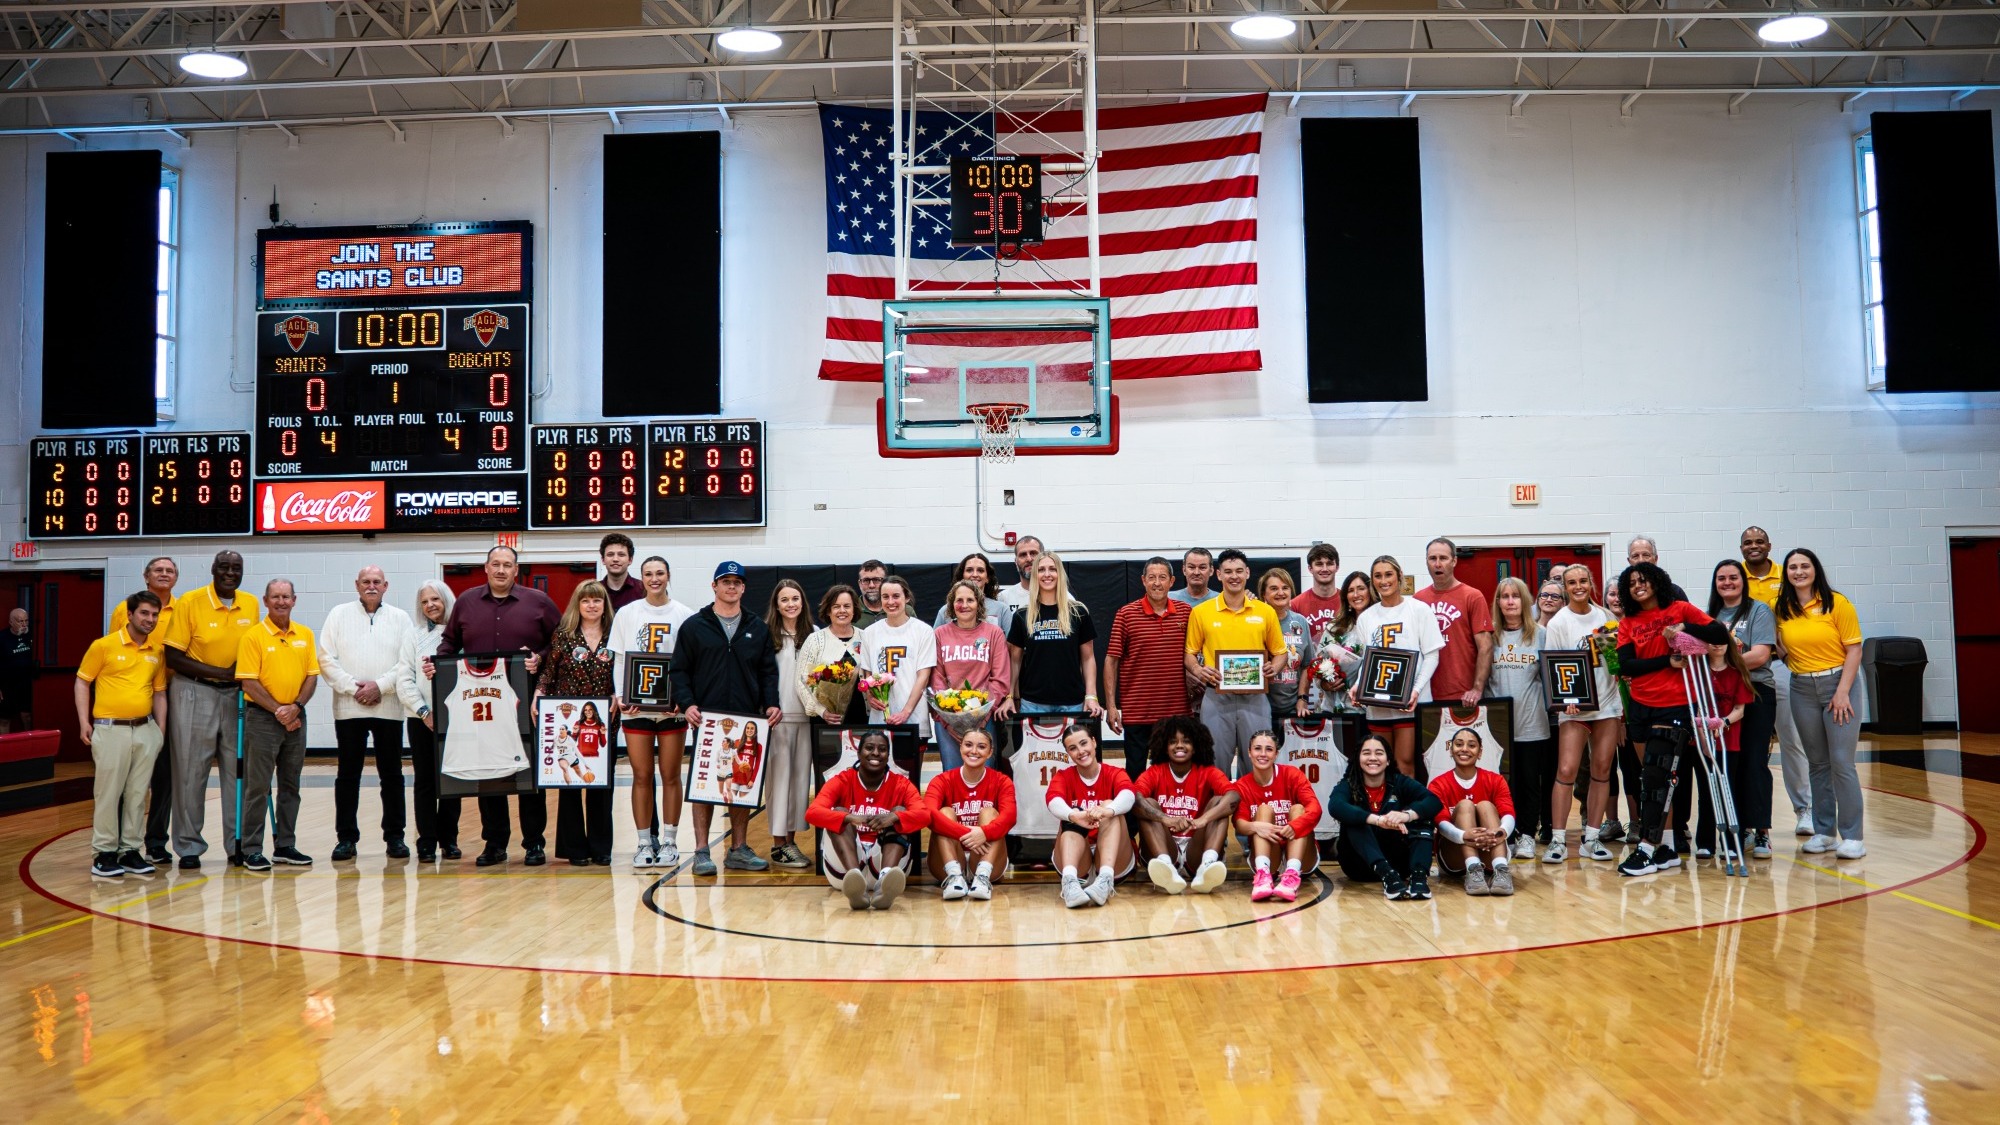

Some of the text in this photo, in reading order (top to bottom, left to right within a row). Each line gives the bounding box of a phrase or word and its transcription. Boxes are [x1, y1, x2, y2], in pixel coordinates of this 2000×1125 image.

[974, 192, 1022, 234] 30
[331, 242, 434, 264] JOIN THE
[316, 266, 463, 290] SAINTS CLUB
[358, 312, 438, 346] 10:00
[275, 356, 326, 373] SAINTS
[371, 364, 408, 375] PERIOD
[448, 352, 512, 368] BOBCATS
[306, 378, 325, 411] 0
[393, 381, 398, 404] 1
[490, 374, 508, 406] 0
[268, 416, 302, 428] FOULS
[314, 416, 342, 426] T.O.L.
[354, 414, 426, 426] PLAYER FOUL
[436, 412, 466, 424] T.O.L.
[479, 411, 514, 422] FOULS
[282, 430, 296, 456] 0
[320, 432, 336, 453] 4
[444, 428, 460, 450] 4
[492, 426, 507, 450] 0
[538, 427, 632, 444] PLYR FLS PTS
[654, 425, 750, 442] PLYR FLS PTS
[37, 440, 128, 456] PLYR FLS PTS
[150, 436, 240, 454] PLYR FLS PTS
[268, 462, 302, 474] SCORE
[371, 460, 408, 472] MATCH
[478, 458, 512, 469] SCORE
[554, 450, 634, 470] 0 0 0
[666, 448, 752, 468] 12 0 0
[53, 462, 129, 482] 2 0 0
[159, 459, 242, 480] 15 0 0
[152, 484, 242, 504] 21 0 0
[548, 476, 634, 496] 10 0 0
[658, 474, 752, 494] 21 0 0
[1516, 485, 1536, 500] EXIT
[46, 487, 129, 507] 10 0 0
[280, 490, 378, 524] Coca-Cola
[396, 491, 518, 507] POWERADE
[46, 512, 128, 532] 14 0 0
[548, 502, 634, 522] 11 0 0
[498, 532, 518, 548] EXIT
[15, 543, 34, 558] EXIT
[1306, 609, 1334, 626] FLAGL
[1431, 602, 1461, 622] AGLER
[648, 623, 672, 652] F
[1284, 636, 1302, 644] OUNCE
[1382, 622, 1402, 648] F
[885, 646, 907, 676] F
[1492, 654, 1536, 664] LAGLER
[639, 665, 662, 694] F
[1374, 660, 1402, 690] F
[1555, 663, 1580, 694] F
[463, 687, 502, 700] FLAGLER
[472, 702, 493, 722] 21
[544, 713, 554, 766] GRIMM
[584, 734, 594, 742] 21
[698, 719, 716, 780] HERRIN
[1028, 751, 1070, 764] FLAGLER
[1288, 750, 1329, 762] FLAGLER
[1158, 794, 1198, 812] FLAGLER
